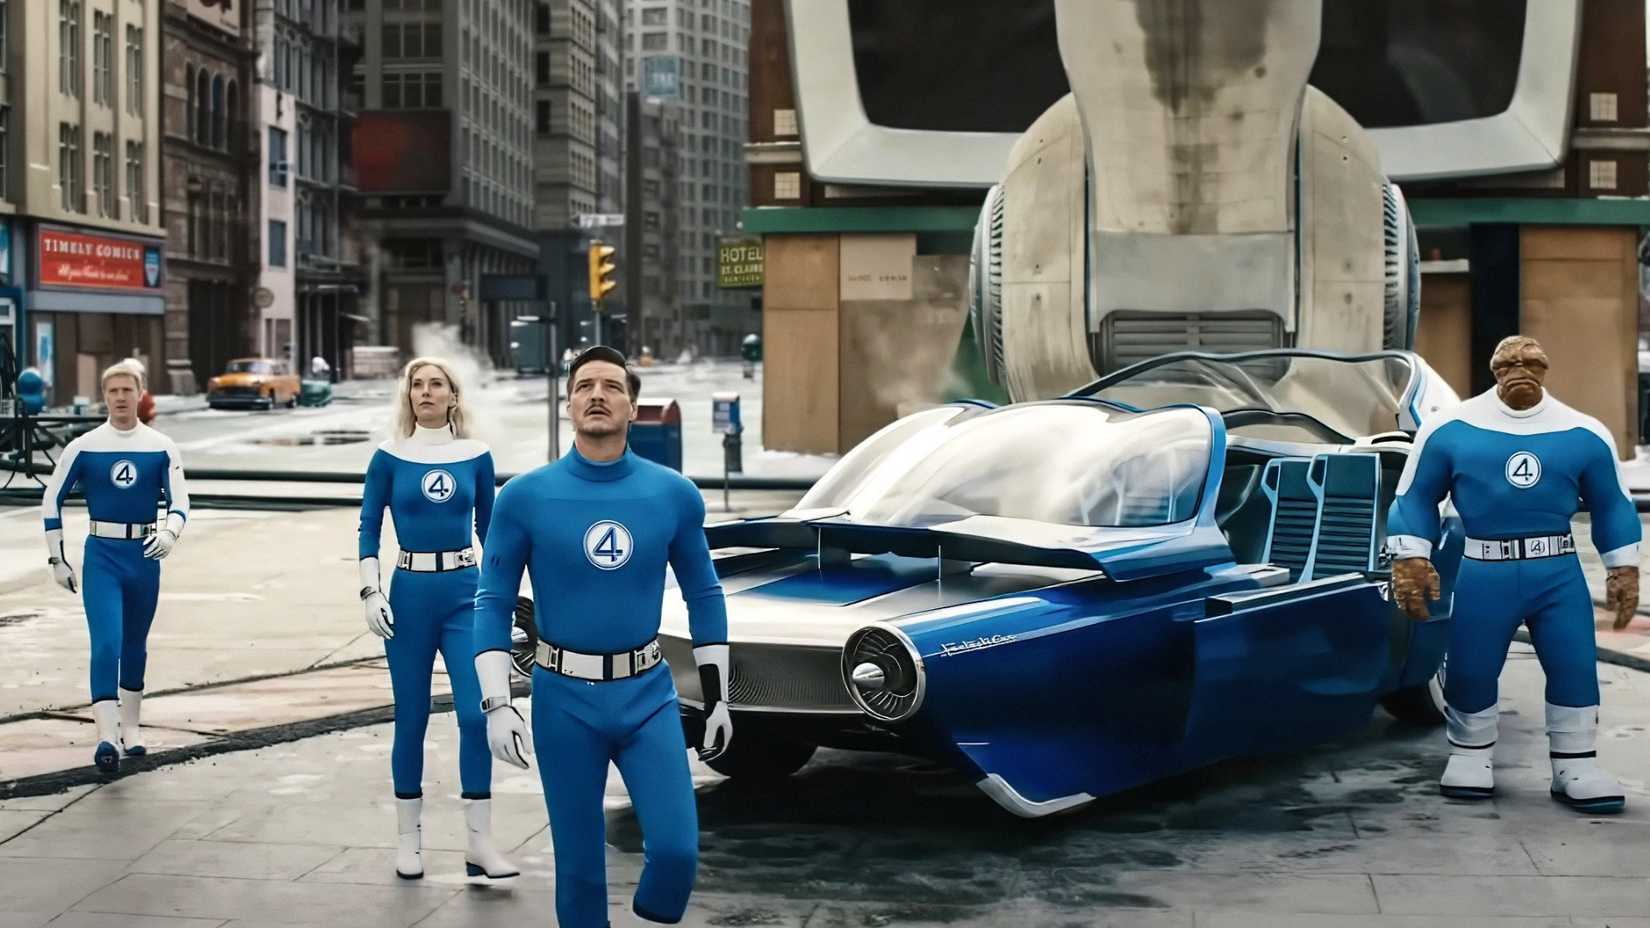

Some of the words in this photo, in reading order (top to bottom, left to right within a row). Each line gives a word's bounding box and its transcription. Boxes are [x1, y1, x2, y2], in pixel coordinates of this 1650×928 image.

[44, 239, 93, 256] TIMELY
[95, 244, 140, 260] COMICS
[720, 247, 764, 263] HOTEL
[115, 464, 134, 484] 4
[1512, 458, 1533, 481] 4
[428, 474, 449, 497] 4
[593, 527, 623, 562] 4
